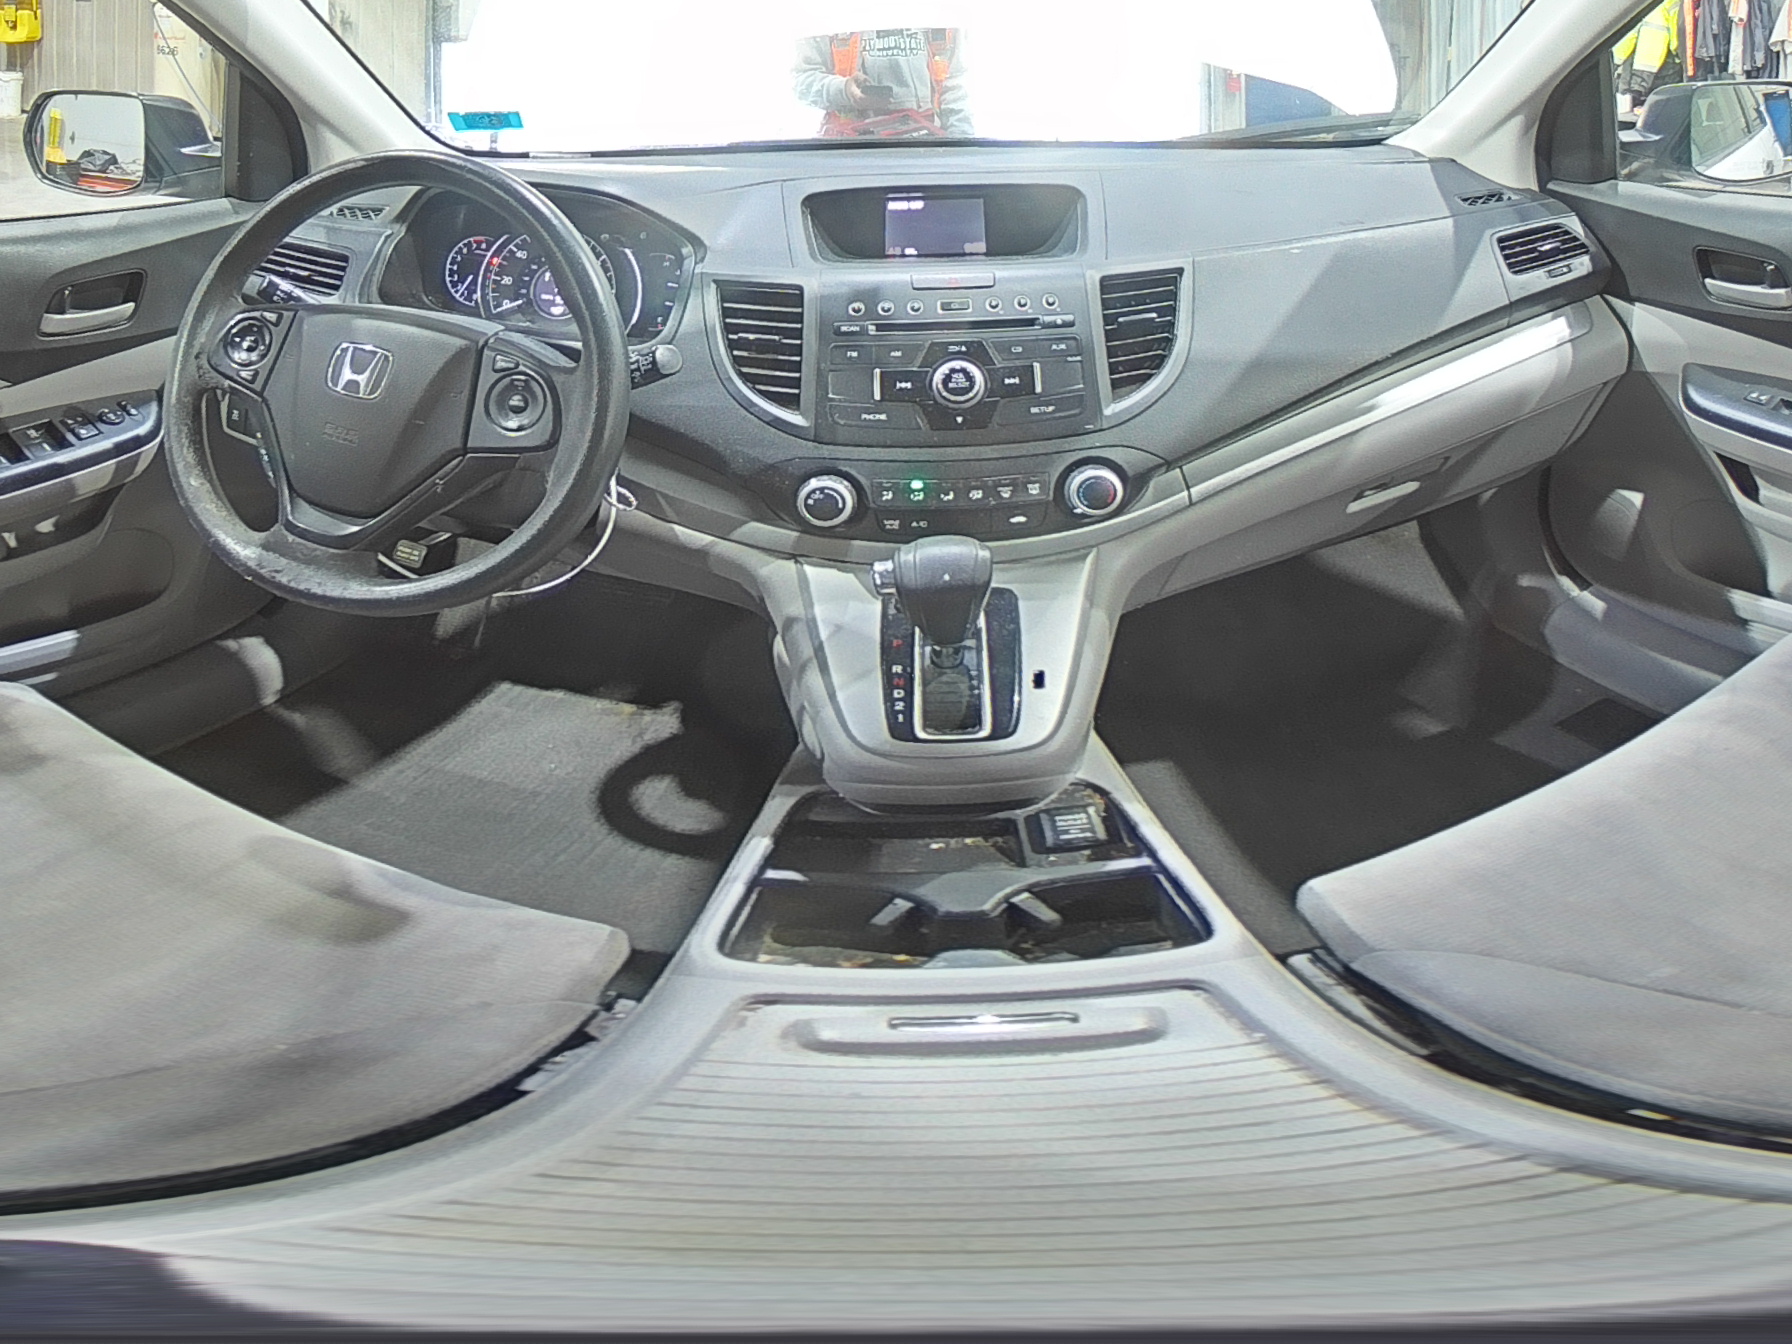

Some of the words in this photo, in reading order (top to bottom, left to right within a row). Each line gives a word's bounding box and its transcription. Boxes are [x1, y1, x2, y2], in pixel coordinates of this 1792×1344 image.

[515, 250, 528, 259] 40
[501, 276, 513, 285] 20
[840, 325, 861, 333] SCAN
[1030, 405, 1057, 415] SETUP
[861, 413, 888, 421] PHONE
[892, 639, 903, 647] P
[891, 664, 904, 674] R
[893, 678, 905, 687] N
[893, 689, 905, 698] D
[894, 701, 906, 710] 2
[897, 713, 904, 723] 1
